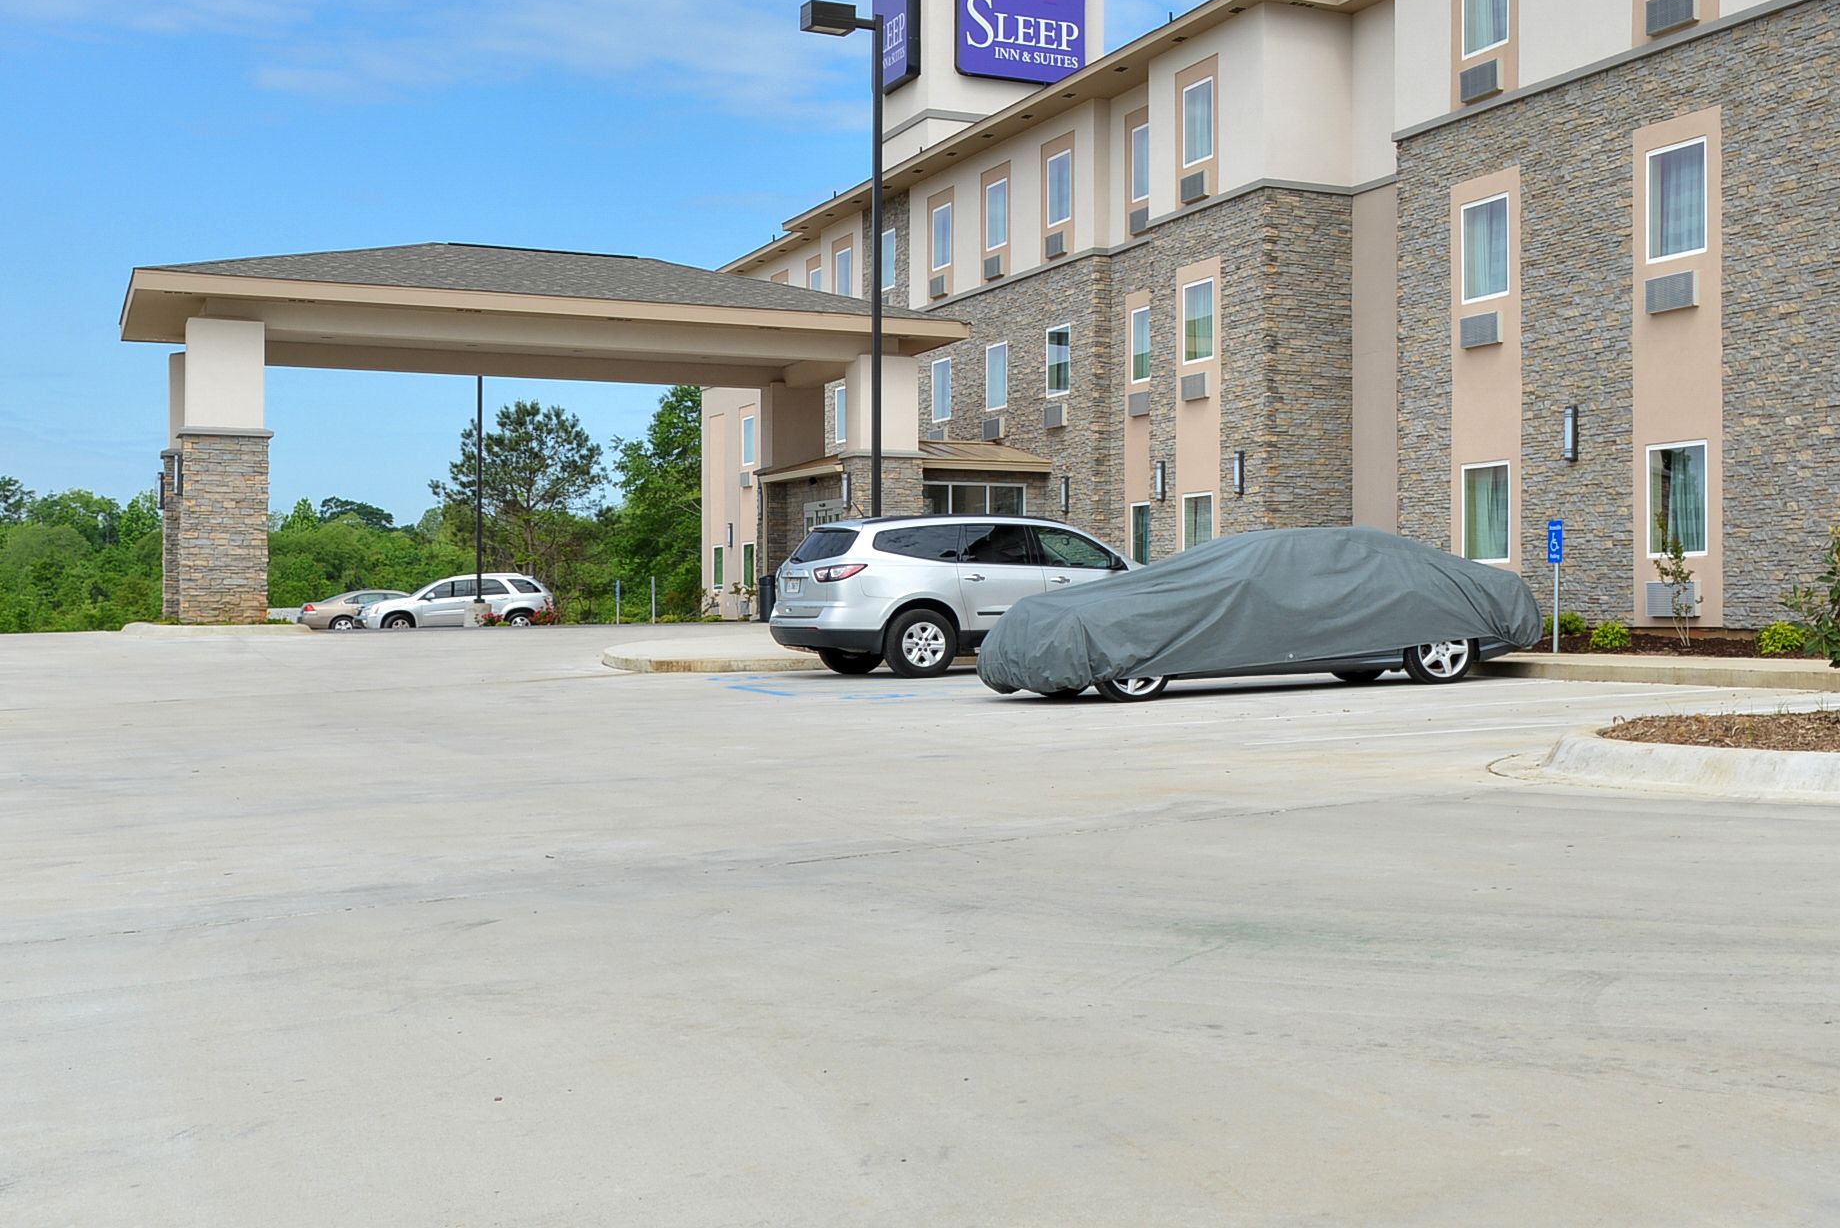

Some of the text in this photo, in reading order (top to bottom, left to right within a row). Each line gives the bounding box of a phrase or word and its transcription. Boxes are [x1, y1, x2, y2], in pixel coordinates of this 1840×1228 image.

[994, 47, 1079, 69] INN & SUITES
